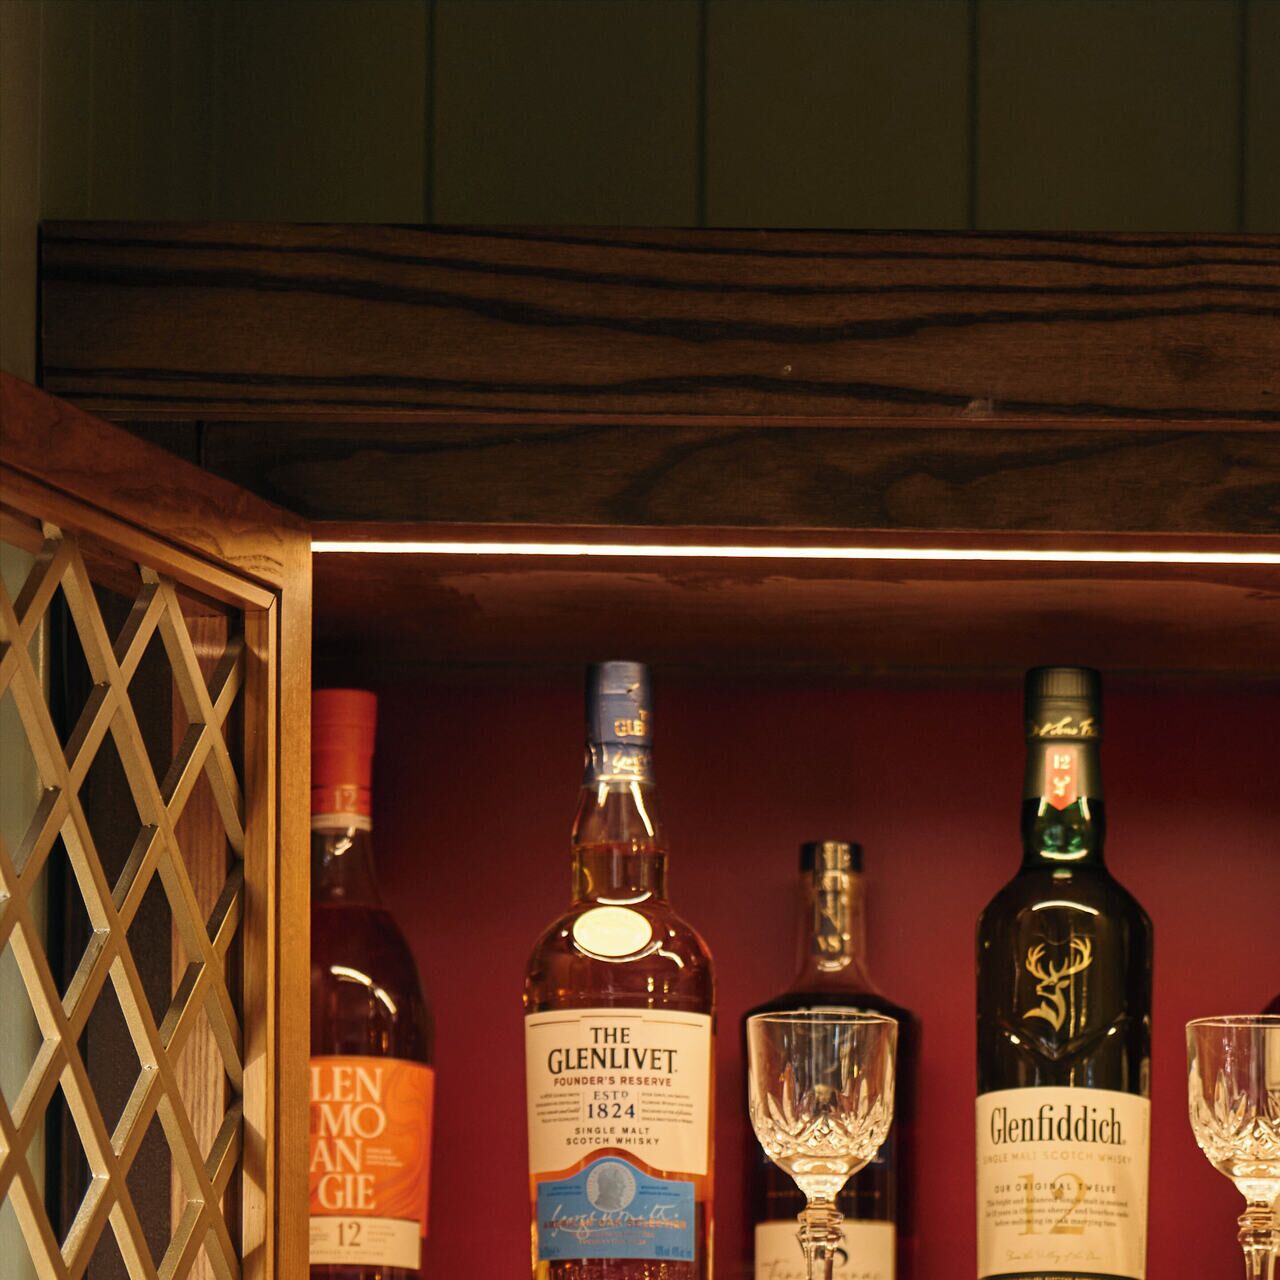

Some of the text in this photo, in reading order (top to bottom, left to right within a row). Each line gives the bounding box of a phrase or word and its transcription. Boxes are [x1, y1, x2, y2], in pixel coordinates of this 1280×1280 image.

[1053, 754, 1071, 769] 12
[590, 1027, 631, 1044] THE
[547, 1048, 678, 1075] GLENLIVET
[310, 1066, 383, 1103] LEN
[554, 1076, 672, 1087] FOUNDER'S RESERVE
[587, 1103, 635, 1119] 1824
[575, 1127, 650, 1135] SINGLE MALT
[990, 1103, 1122, 1145] Glenfiddich
[566, 1137, 660, 1146] SCOTCH WHISKY
[310, 1139, 363, 1172] AN
[1011, 1152, 1037, 1161] MALT
[1044, 1151, 1093, 1161] SCOTCH
[1097, 1154, 1131, 1165] WHISKY
[317, 1173, 376, 1210] GIE
[994, 1183, 1117, 1193] OUR ORIGINAL TWELVE
[1017, 1172, 1088, 1236] 12
[337, 1221, 362, 1246] 12
